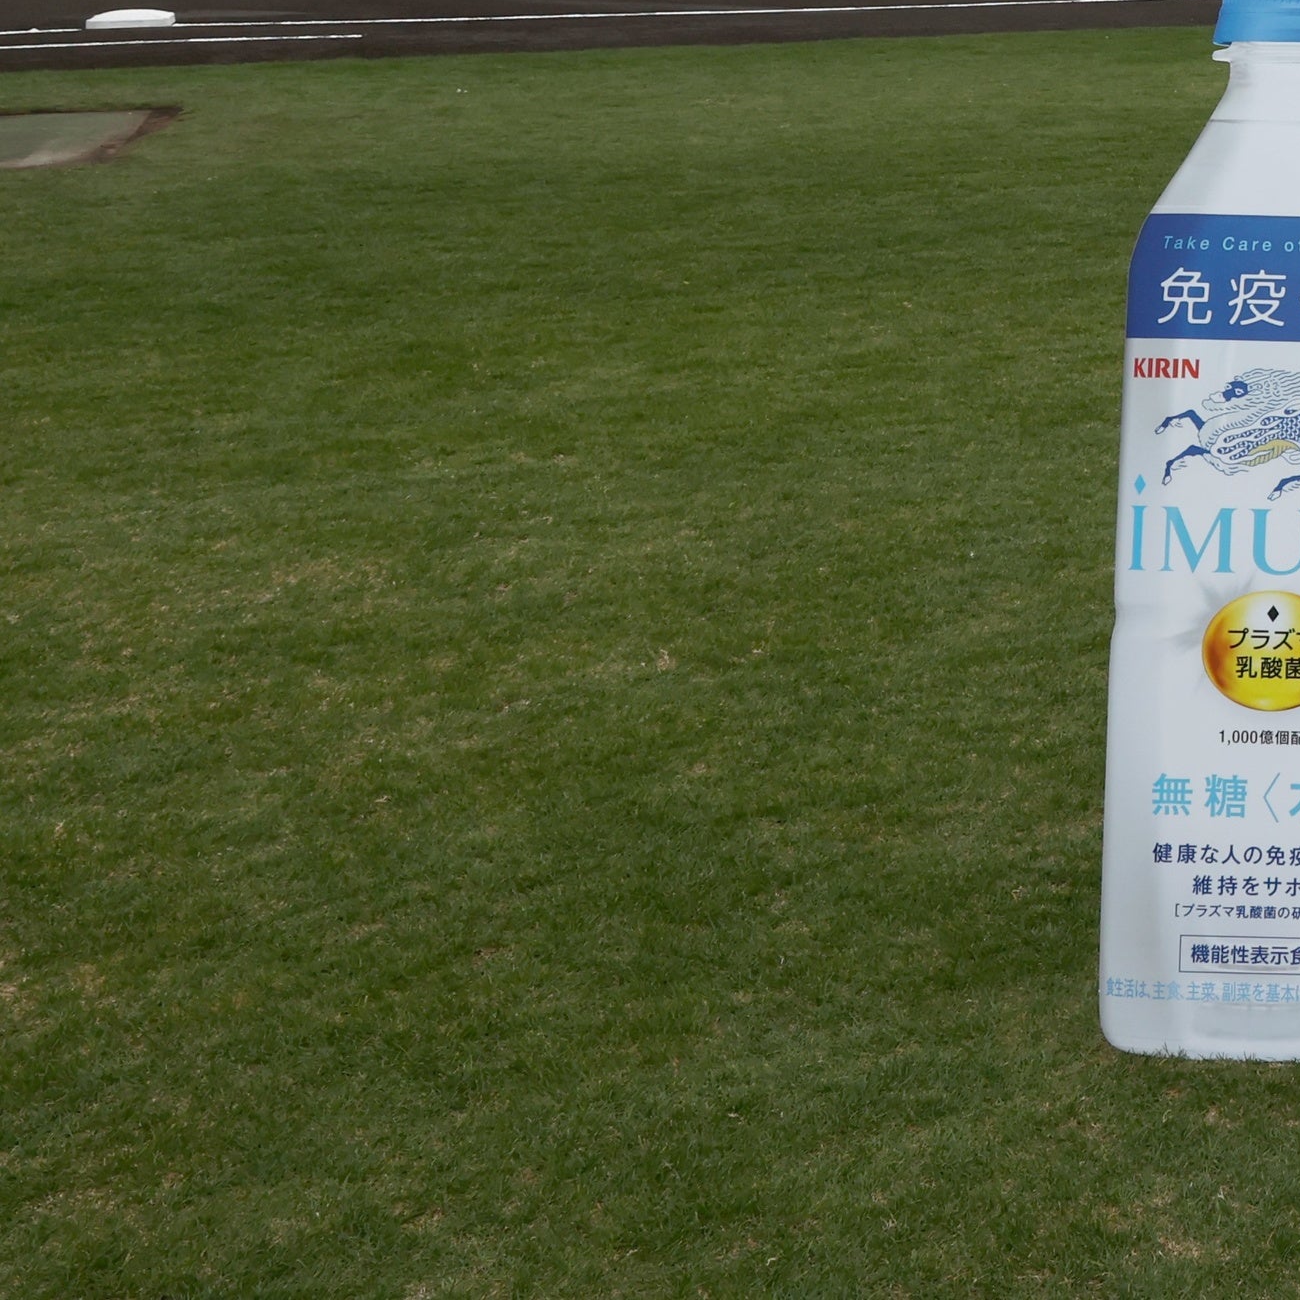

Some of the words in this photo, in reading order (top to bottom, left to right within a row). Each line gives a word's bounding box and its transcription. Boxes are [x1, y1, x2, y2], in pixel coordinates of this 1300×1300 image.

[1163, 235, 1210, 250] Take
[1222, 236, 1272, 252] Care
[1133, 357, 1200, 379] KIRIN
